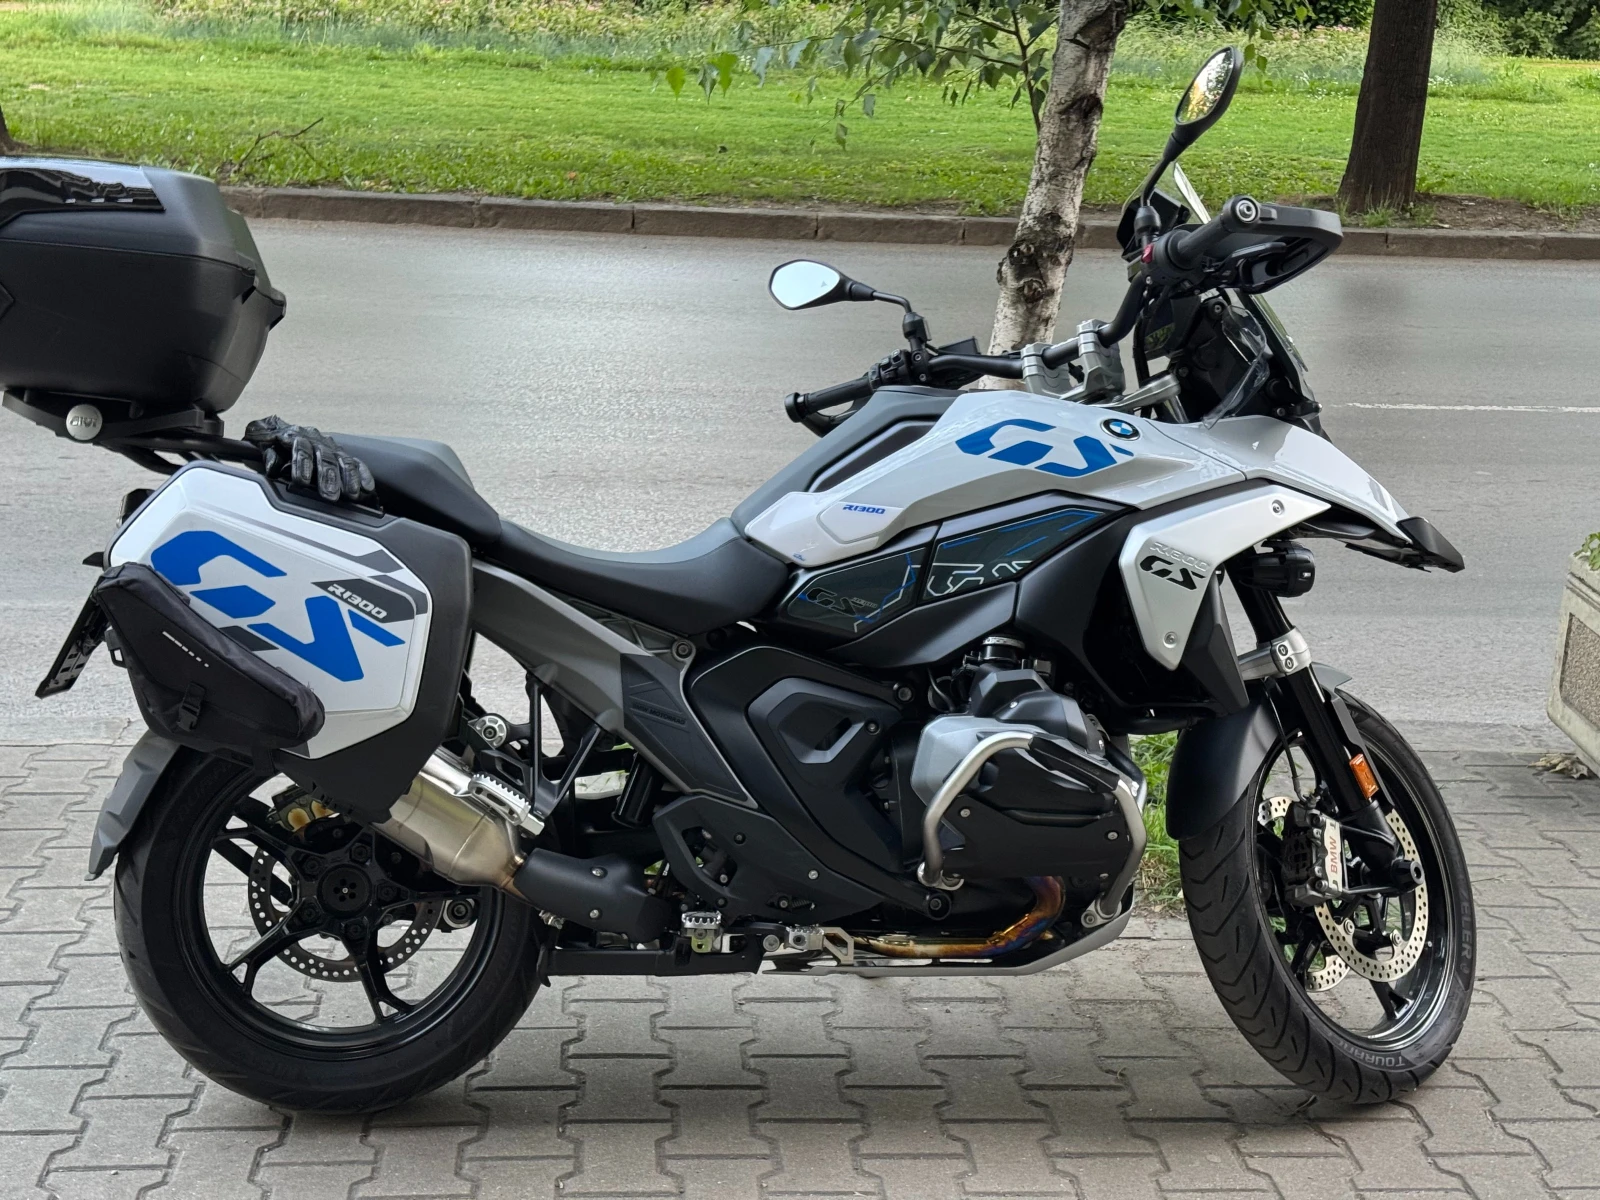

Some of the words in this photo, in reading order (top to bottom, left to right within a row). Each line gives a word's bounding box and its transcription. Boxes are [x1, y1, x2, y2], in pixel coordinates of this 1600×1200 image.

[843, 504, 886, 515] R1300
[1140, 555, 1206, 591] GS
[327, 583, 388, 619] R1300
[1329, 835, 1338, 875] BMW
